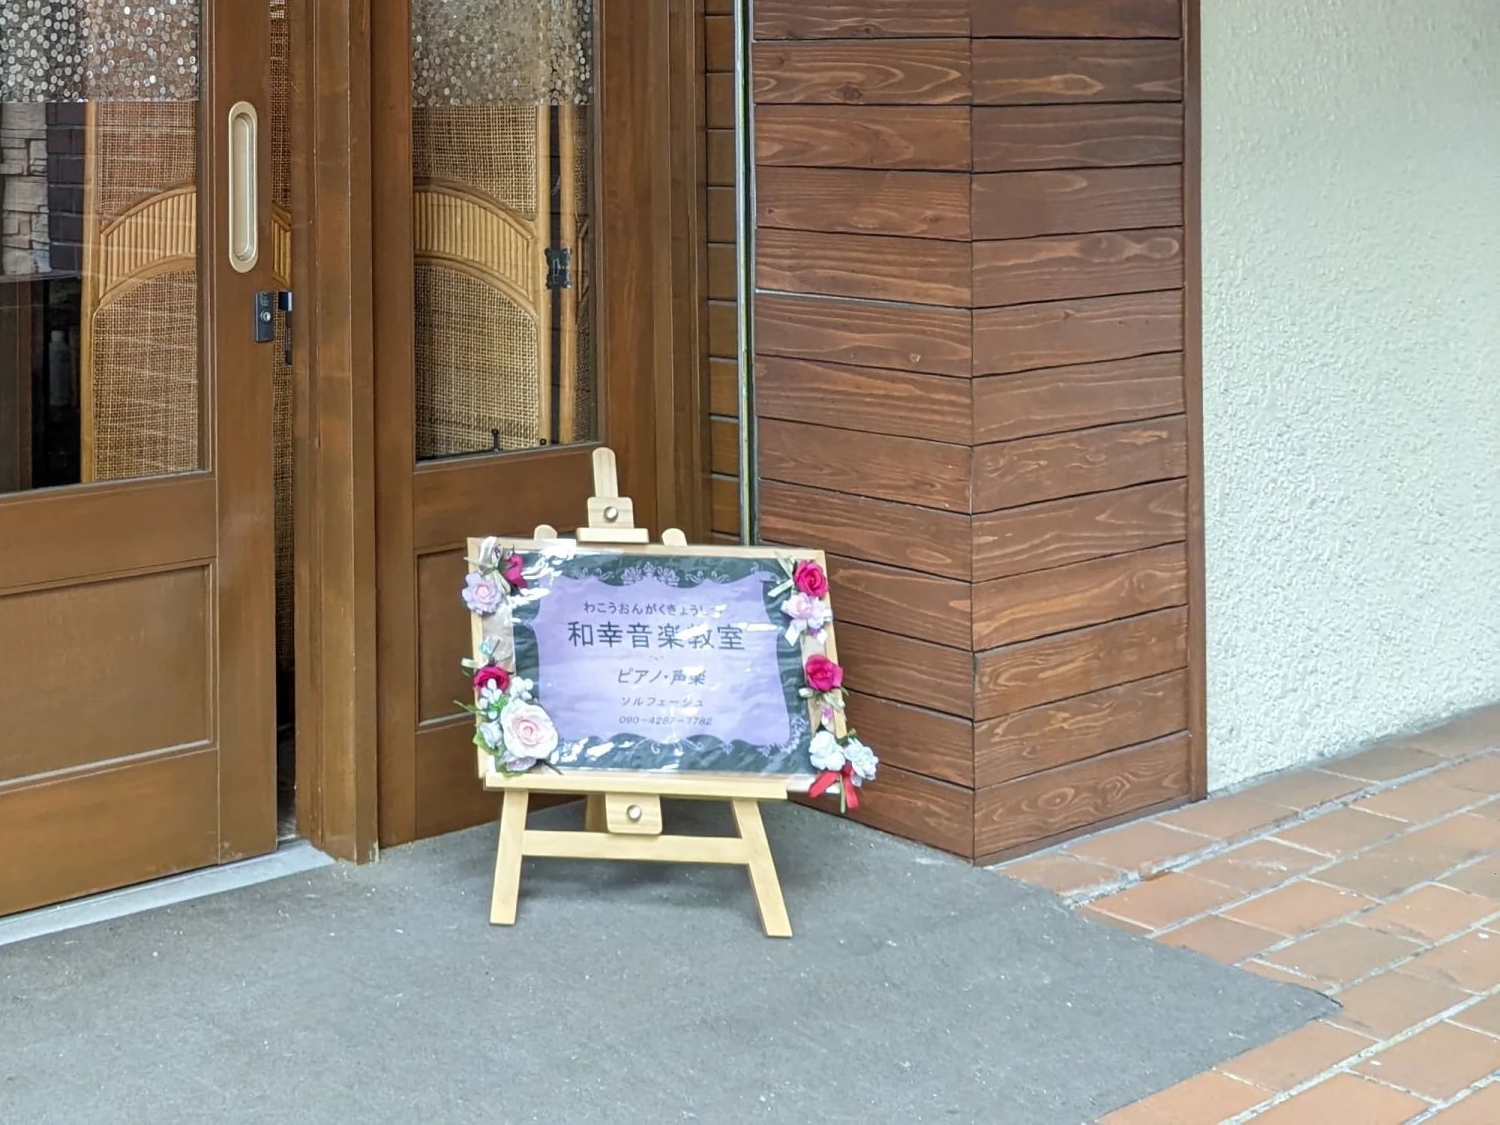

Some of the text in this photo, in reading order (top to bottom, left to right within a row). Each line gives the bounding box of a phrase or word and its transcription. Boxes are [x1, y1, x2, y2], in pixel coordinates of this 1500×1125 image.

[583, 600, 727, 617] わこうおんがくきょうし
[566, 620, 746, 651] 和幸音楽教室
